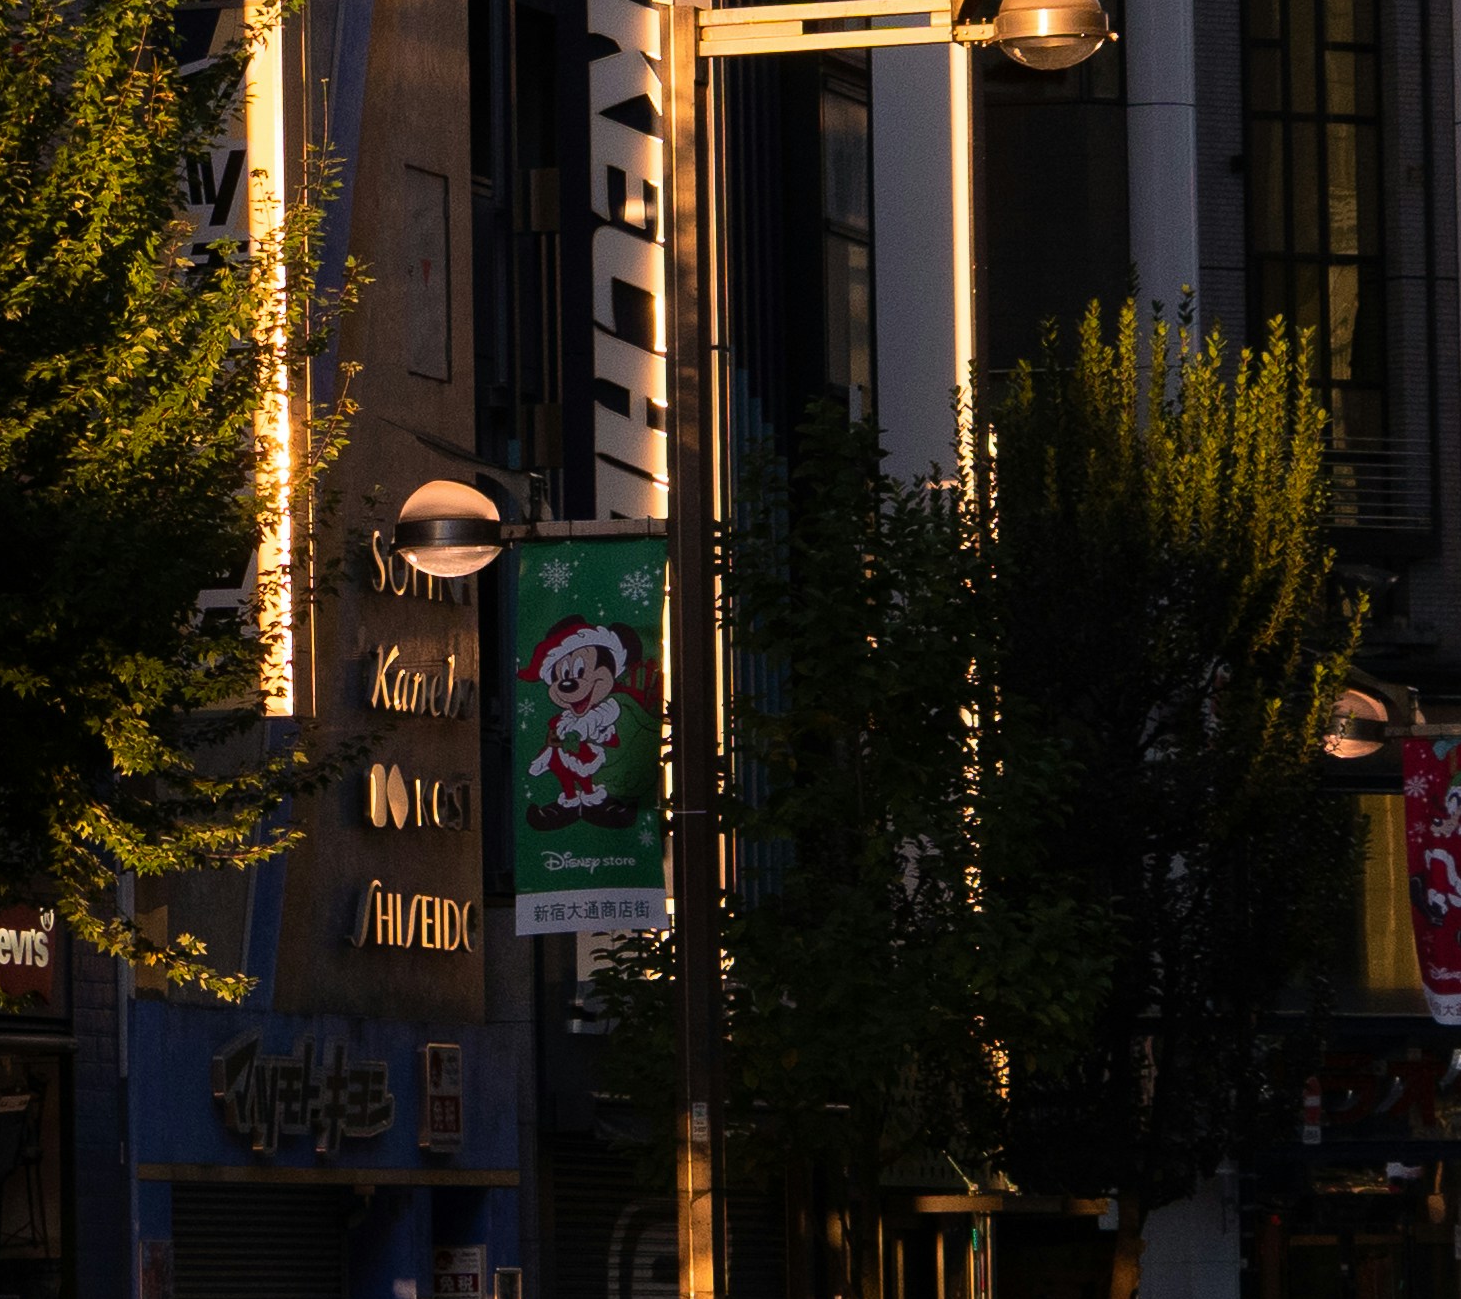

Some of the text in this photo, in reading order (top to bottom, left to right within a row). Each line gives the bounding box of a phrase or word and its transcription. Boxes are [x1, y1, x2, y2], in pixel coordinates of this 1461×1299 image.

[532, 900, 651, 924] 新宿大通商店街
